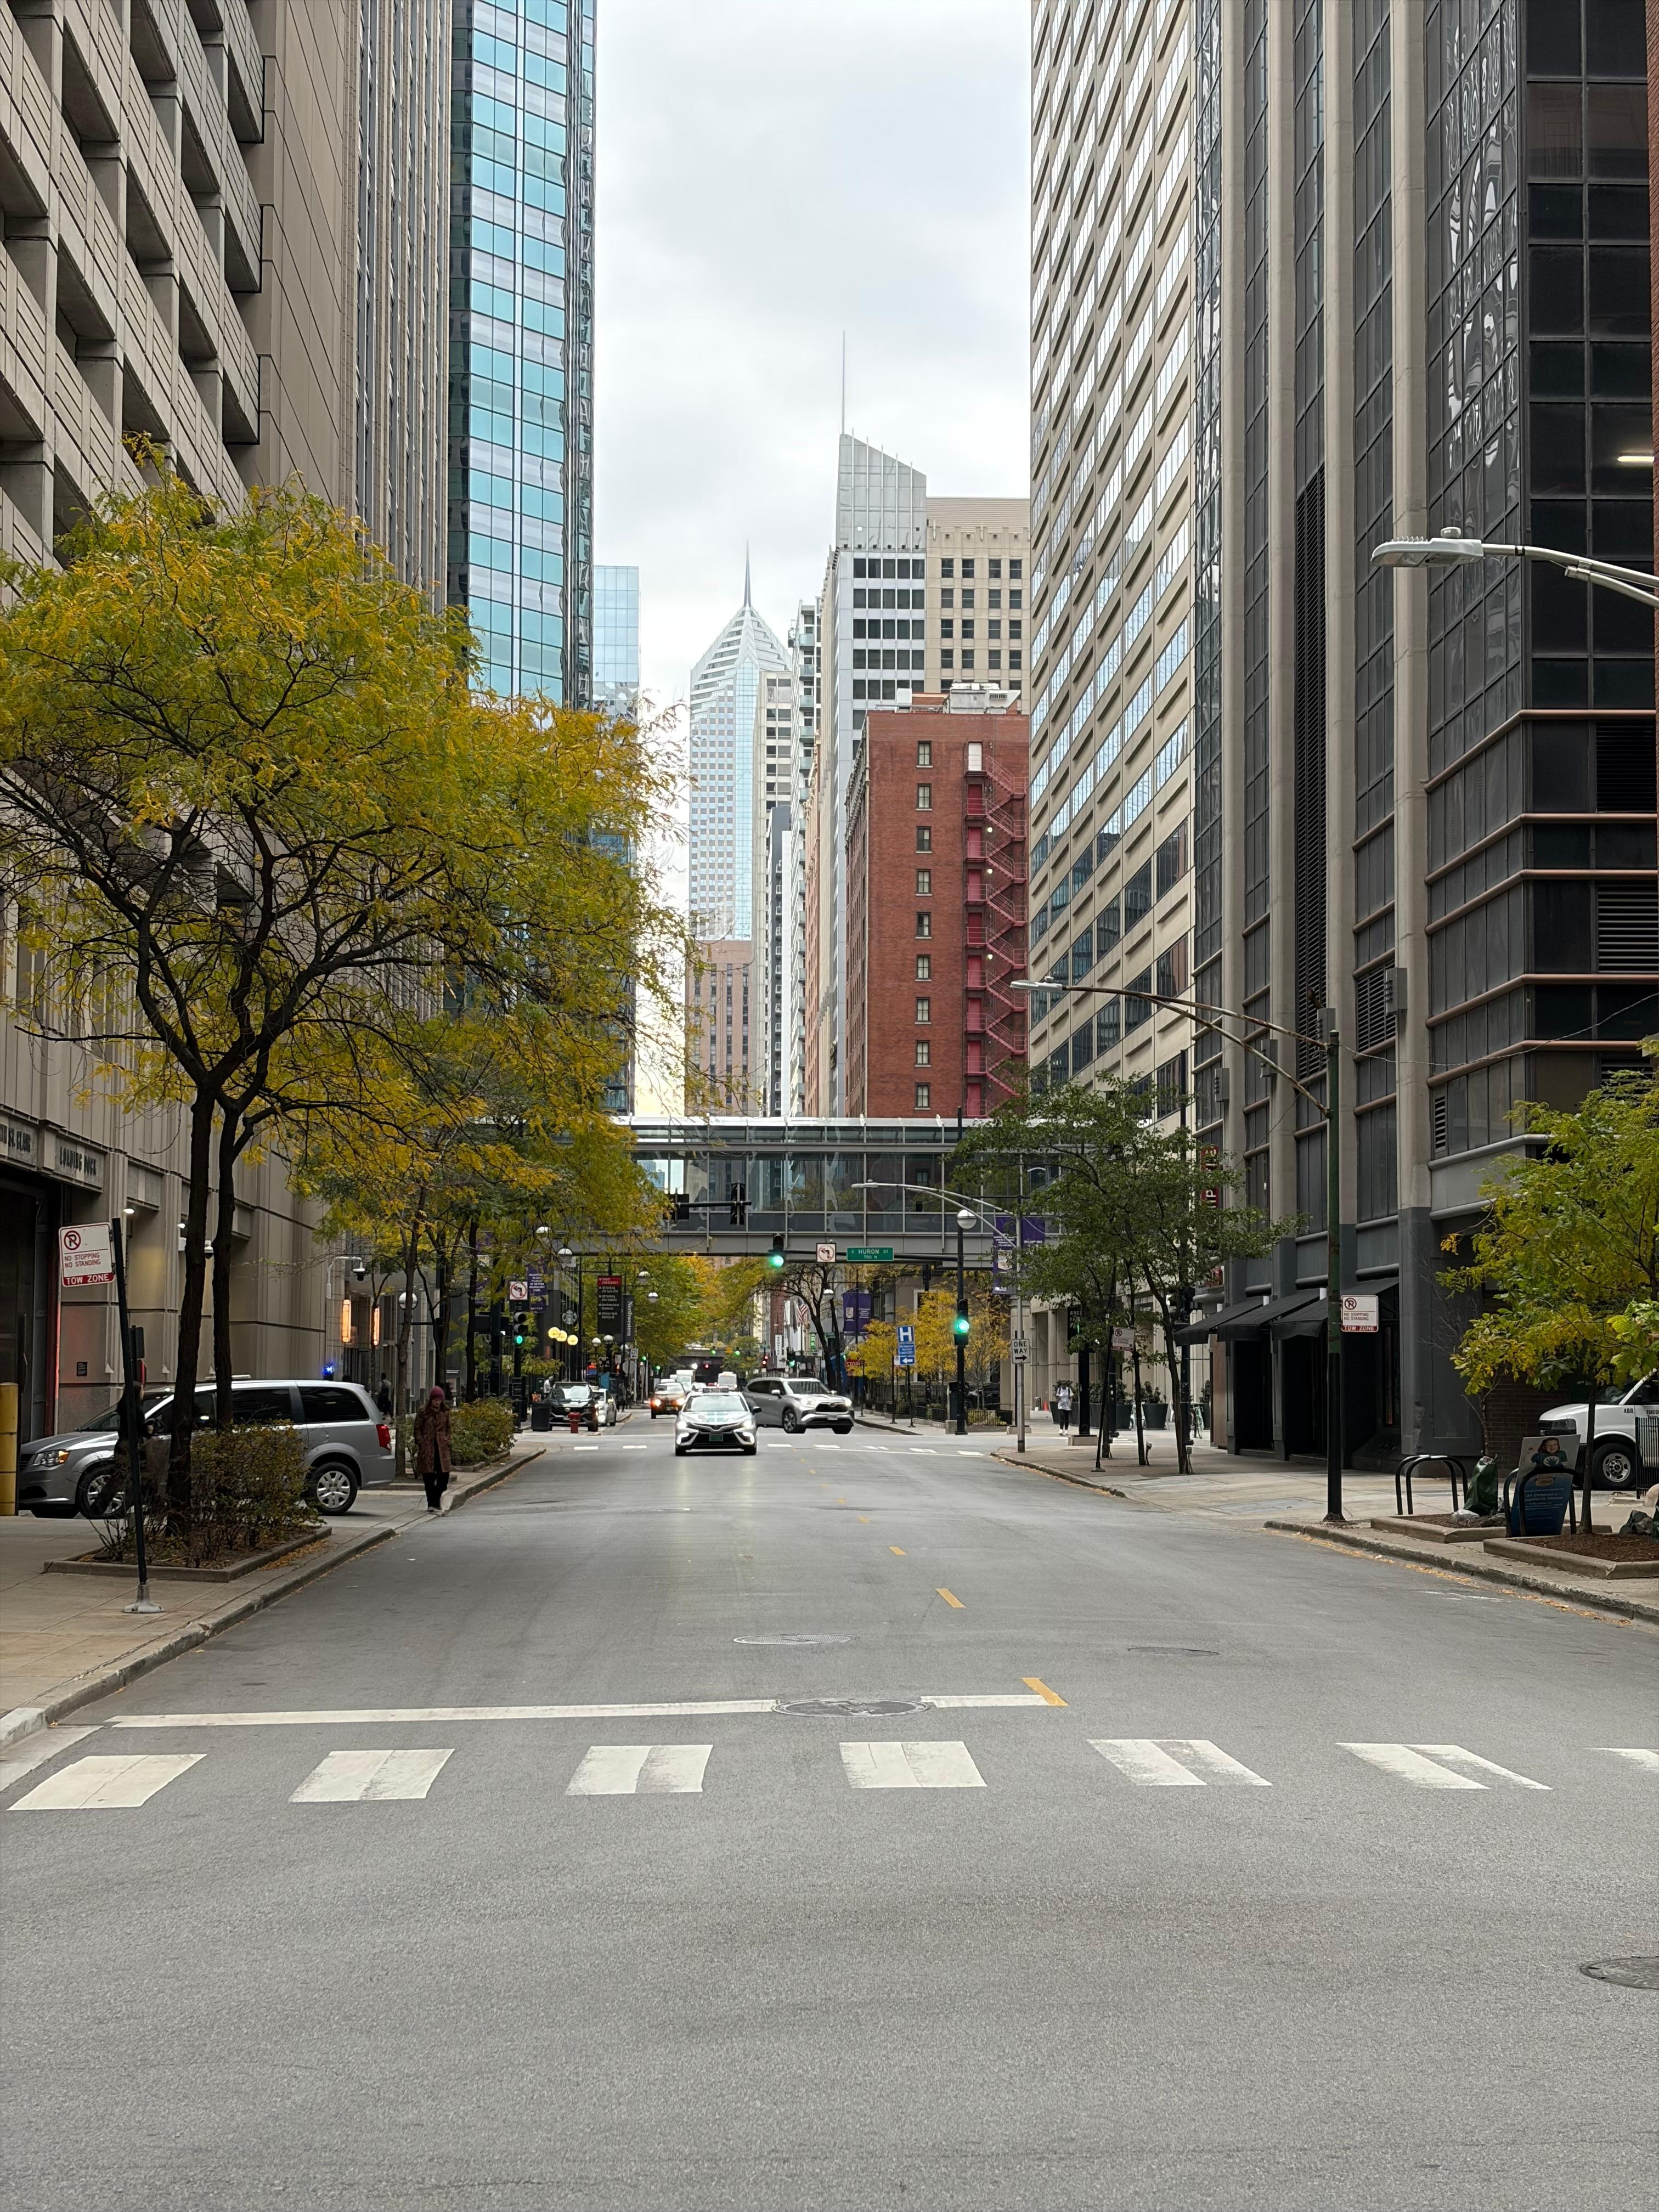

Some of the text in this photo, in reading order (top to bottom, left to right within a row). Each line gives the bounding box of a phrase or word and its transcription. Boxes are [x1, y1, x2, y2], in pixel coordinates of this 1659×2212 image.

[60, 1146, 97, 1176] LOADING DOCK
[75, 1252, 100, 1261] STOPPING
[75, 1259, 101, 1267] STANDING
[66, 1273, 110, 1285] TOW ZONE
[900, 1327, 912, 1342] H
